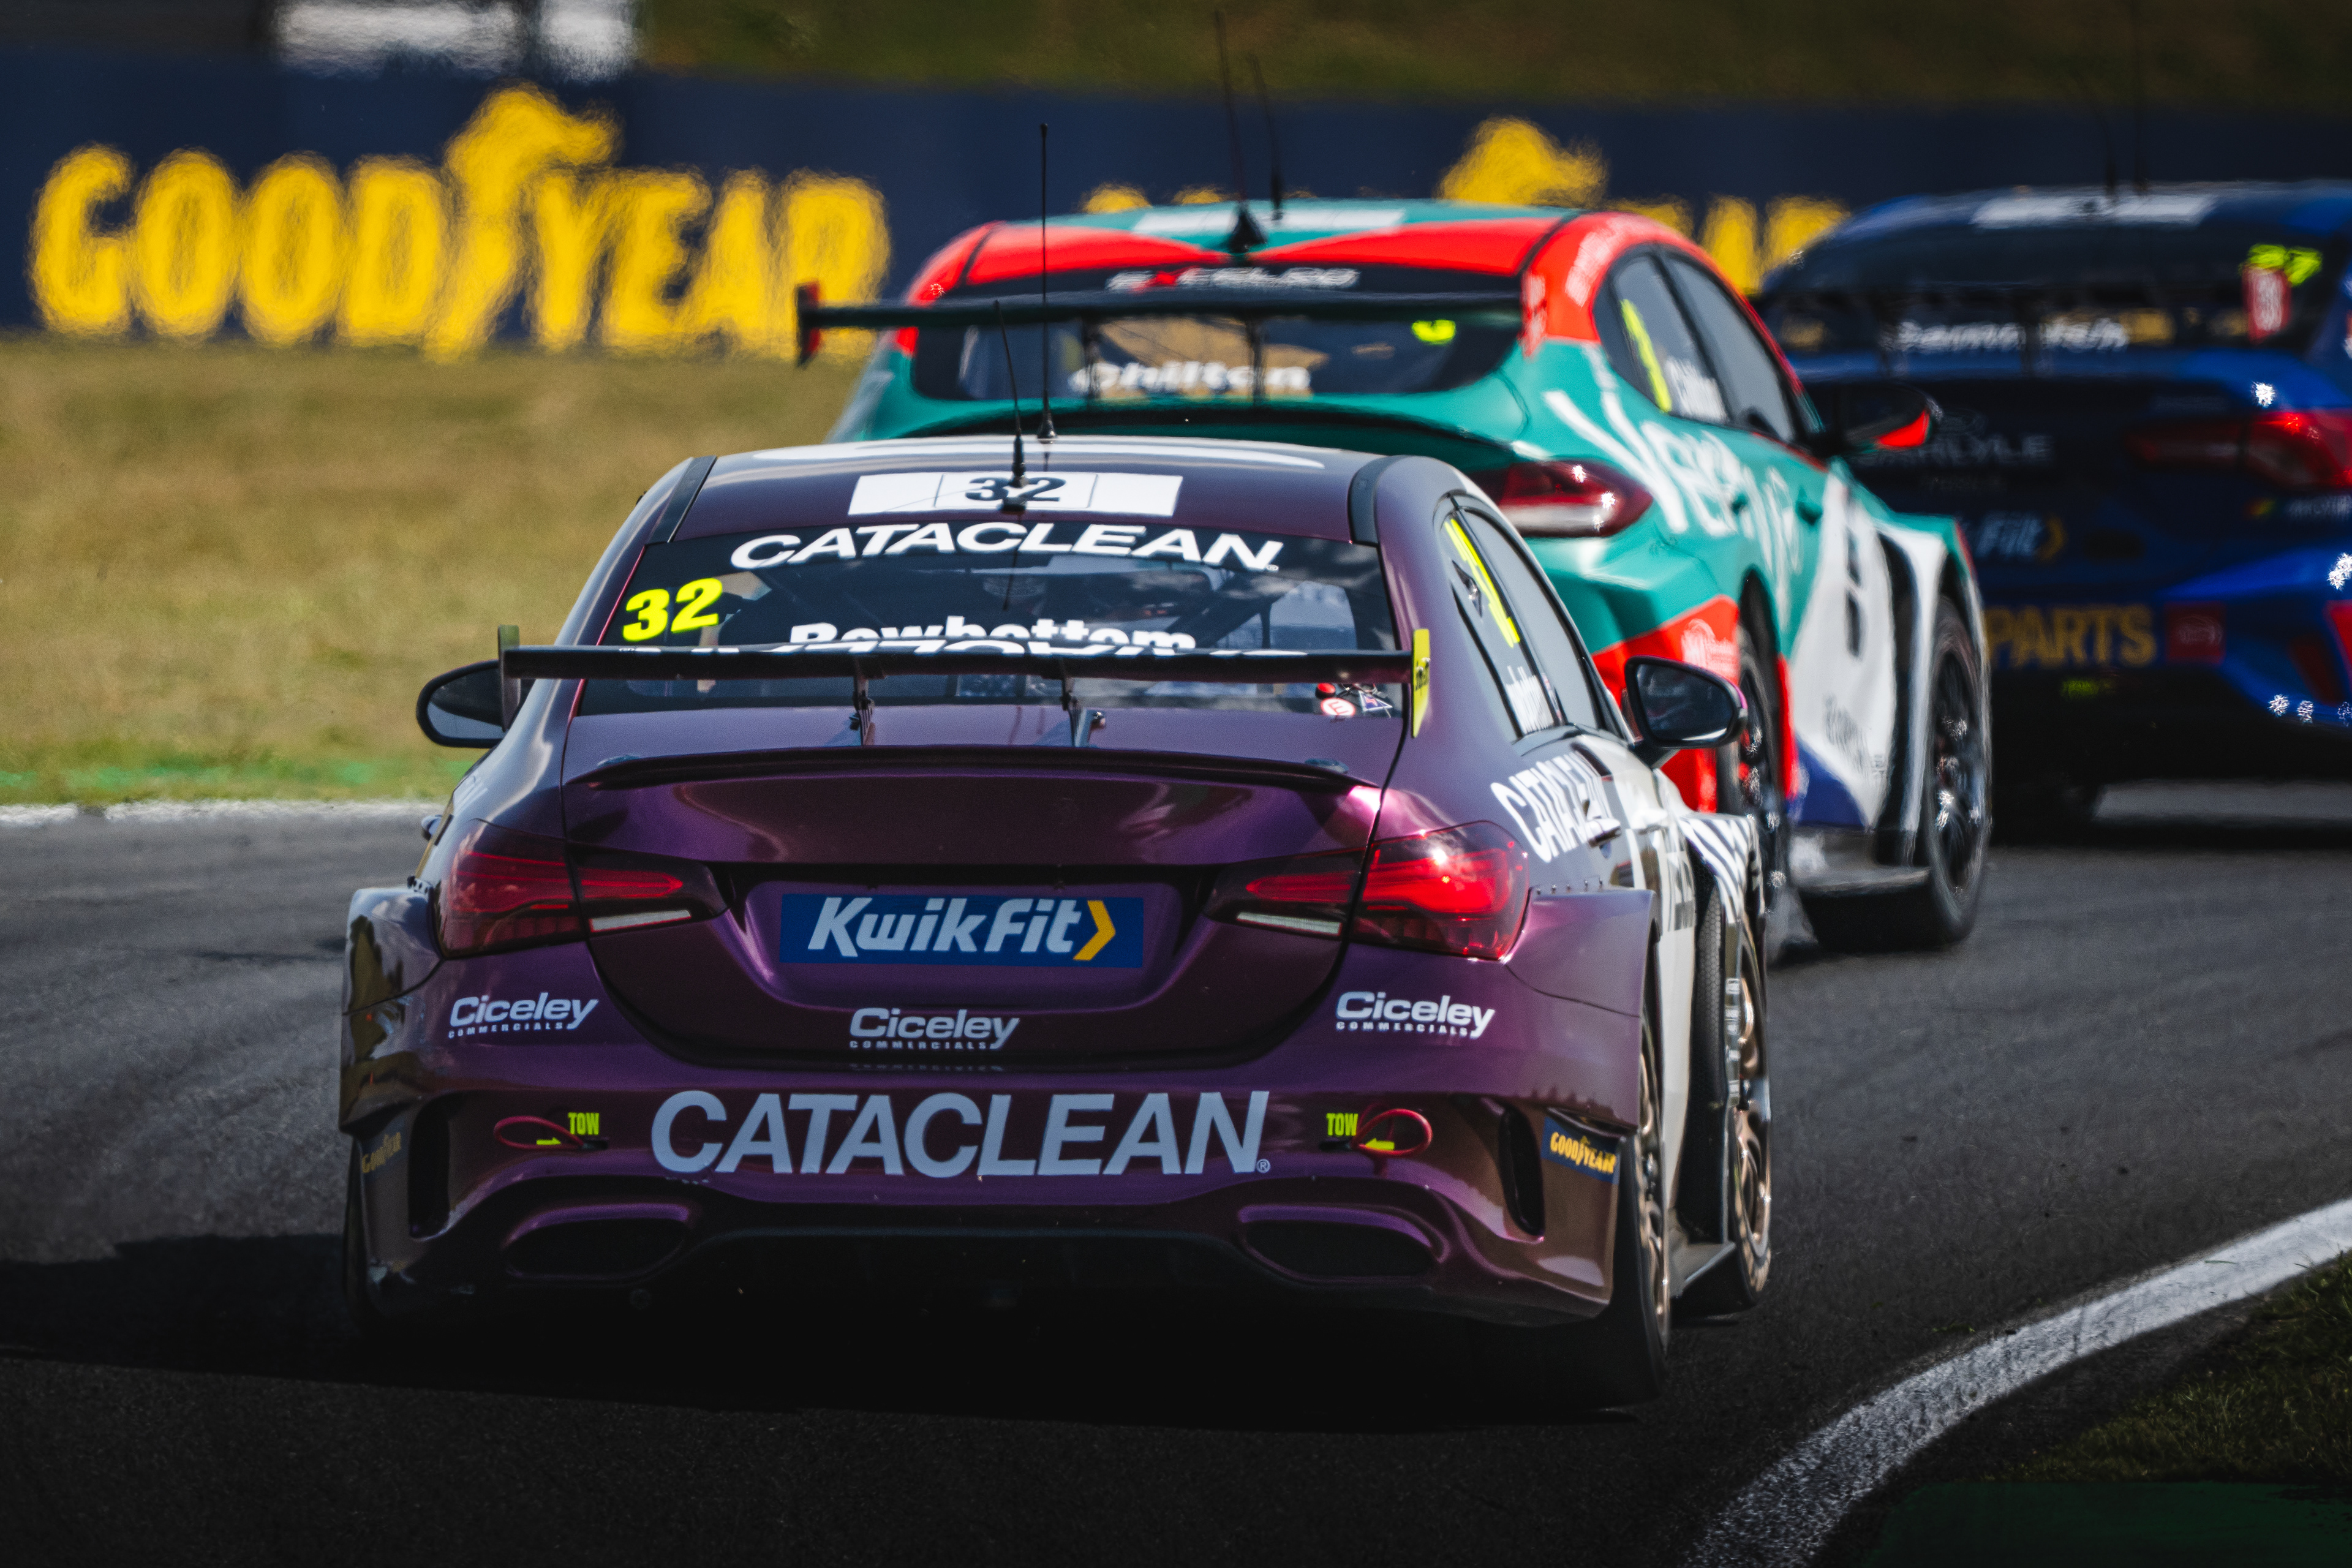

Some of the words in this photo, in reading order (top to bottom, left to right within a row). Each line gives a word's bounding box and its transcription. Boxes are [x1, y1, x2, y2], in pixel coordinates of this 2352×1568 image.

[28, 116, 892, 363] GOODYEAR
[965, 477, 1066, 502] 32
[623, 578, 723, 642] 32
[450, 992, 600, 1030] Ciceley
[1336, 991, 1496, 1039] Ciceley
[448, 1022, 563, 1039] COMMERCIALS
[850, 1008, 1020, 1050] Ciceley
[1336, 1021, 1468, 1037] COMMERCIALS
[850, 1041, 986, 1049] COMMERCIALS
[568, 1112, 600, 1136] TOW
[1326, 1112, 1358, 1136] TOW
[1550, 1131, 1616, 1174] GOODYEAR
